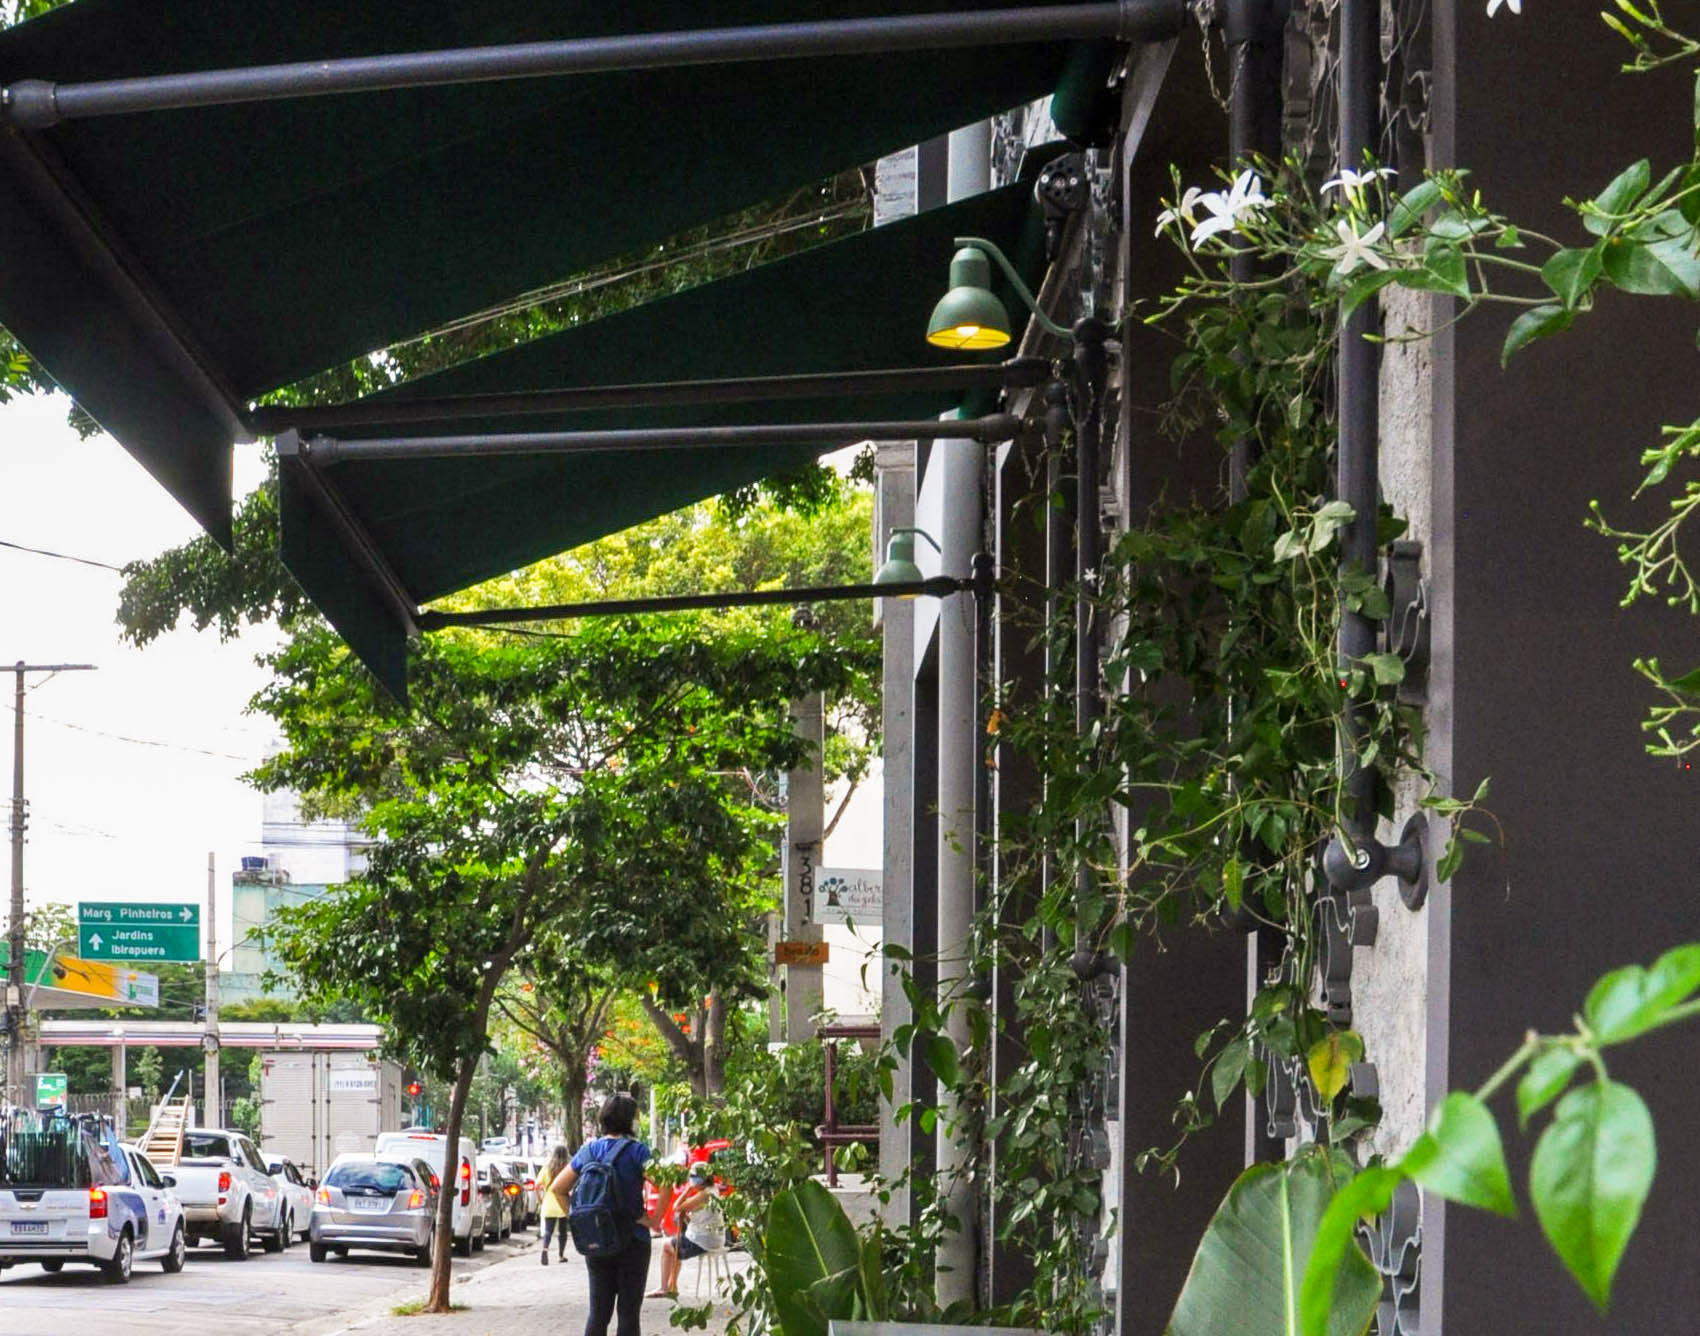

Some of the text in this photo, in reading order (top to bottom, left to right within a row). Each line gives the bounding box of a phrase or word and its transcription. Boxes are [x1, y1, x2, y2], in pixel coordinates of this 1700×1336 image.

[799, 857, 813, 918] 381
[120, 908, 173, 919] Pinheiros
[112, 930, 153, 940] Jardins
[111, 945, 165, 957] Ibirapuera
